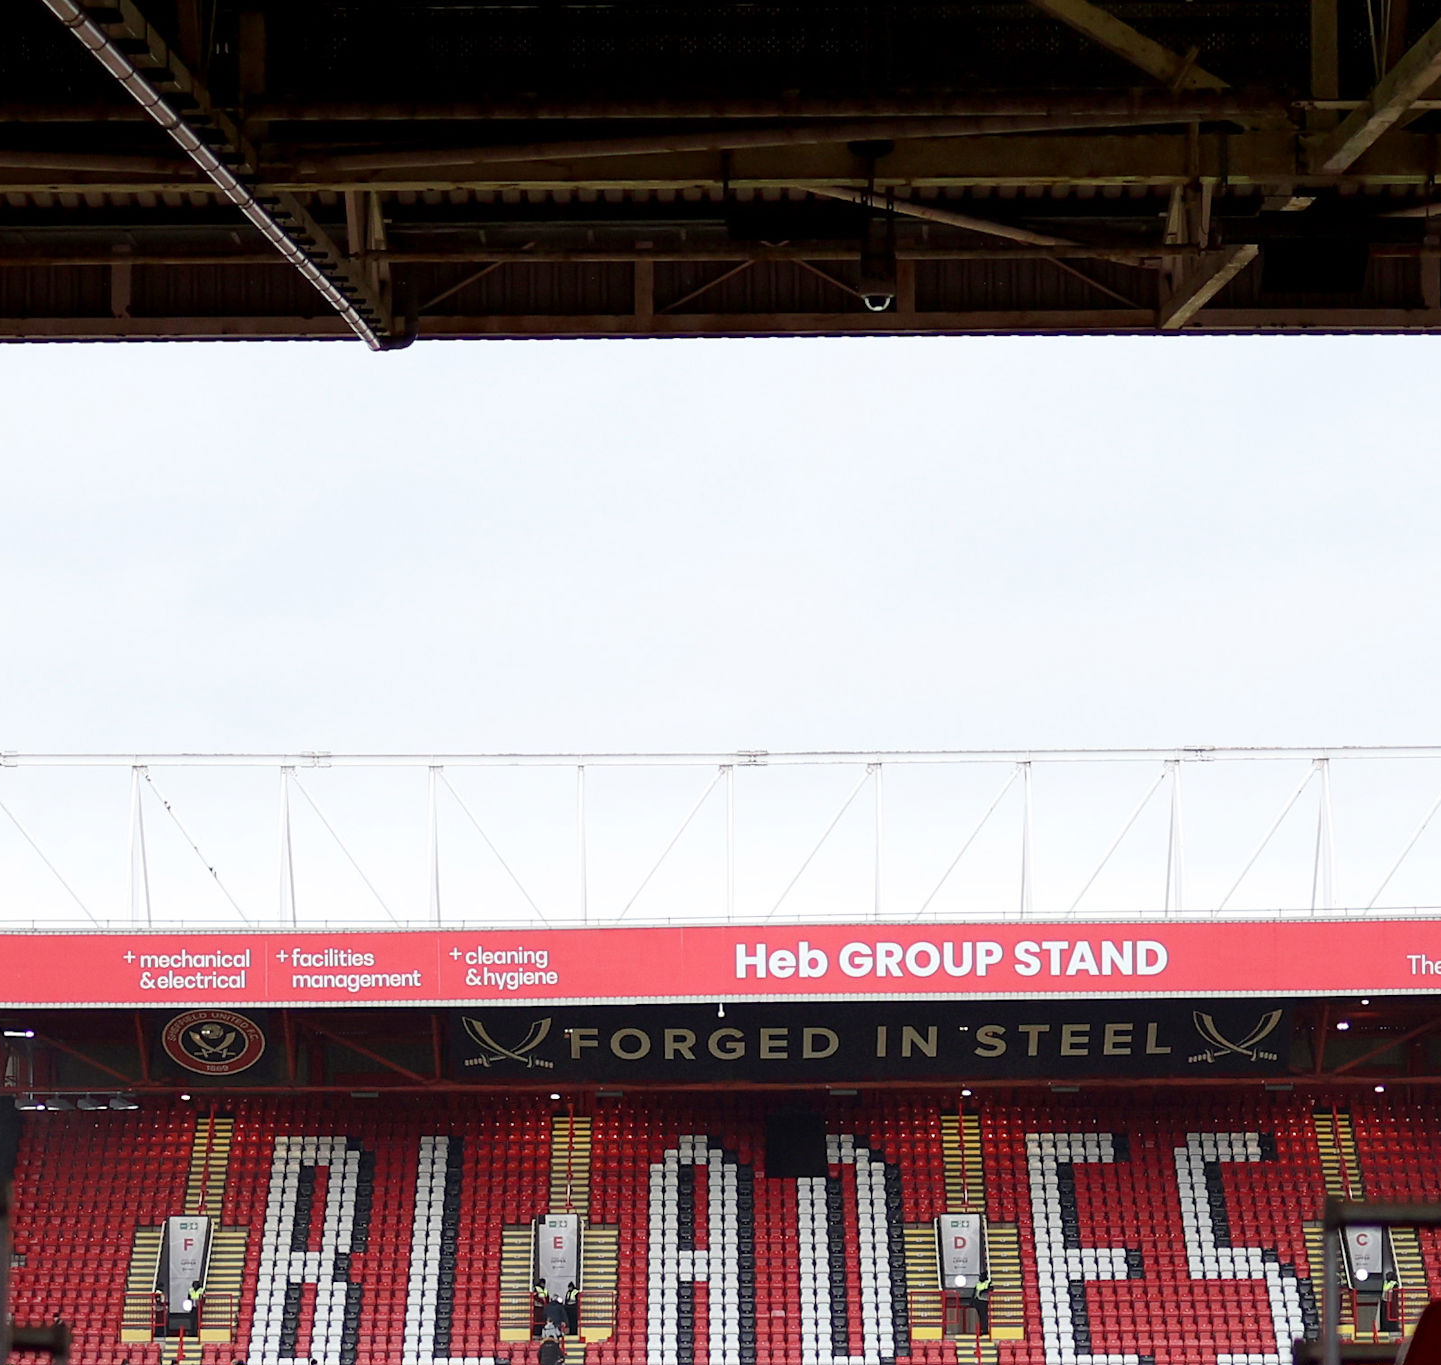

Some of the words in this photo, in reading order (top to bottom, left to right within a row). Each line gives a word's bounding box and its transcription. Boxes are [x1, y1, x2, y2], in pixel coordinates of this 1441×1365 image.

[139, 949, 251, 968] mechanical
[291, 948, 375, 967] facilities
[465, 946, 549, 967] cleaning
[735, 941, 828, 979] Heb
[839, 941, 1003, 978] GROUP
[1014, 940, 1169, 977] STAND
[292, 972, 422, 991] management
[570, 1027, 840, 1060] FORGED
[876, 1025, 938, 1058] IN
[973, 1022, 1172, 1058] STEEL
[183, 1238, 194, 1251] F
[553, 1236, 563, 1249] E
[954, 1236, 967, 1249] D
[1356, 1233, 1368, 1246] C
